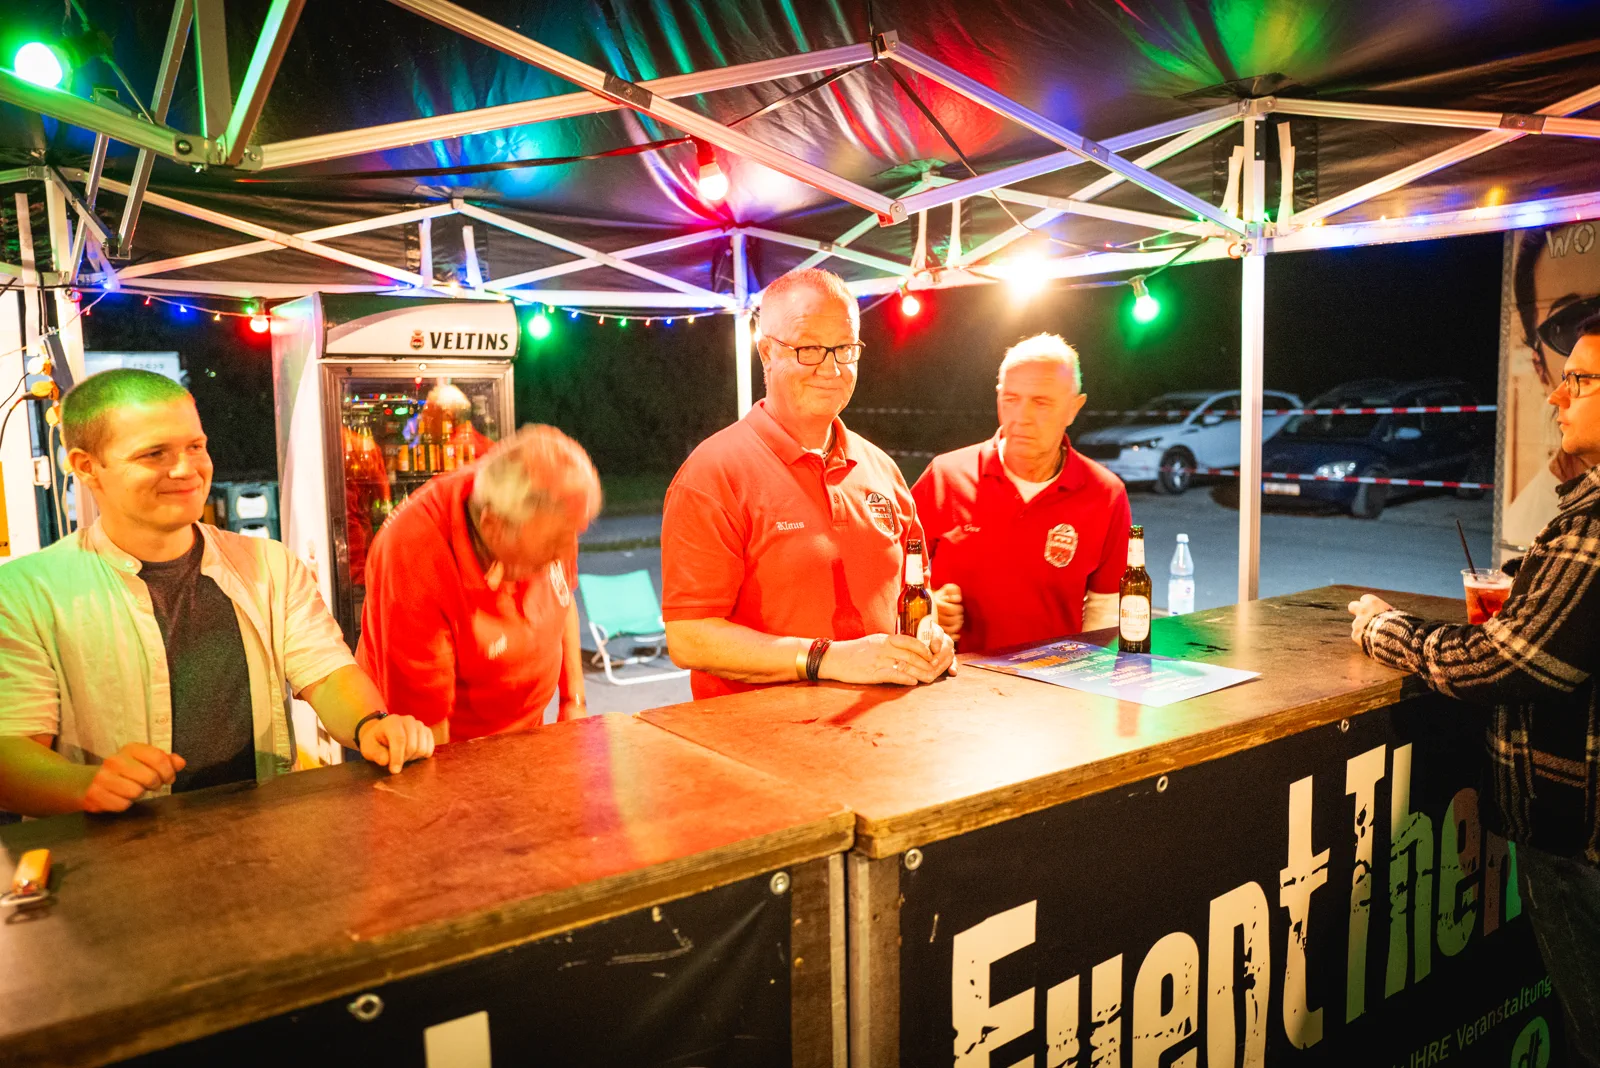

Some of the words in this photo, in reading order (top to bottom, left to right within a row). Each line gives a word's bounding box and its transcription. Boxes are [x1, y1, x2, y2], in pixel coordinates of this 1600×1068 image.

[1545, 223, 1596, 258] WO
[430, 331, 509, 350] VELTINS
[1410, 1033, 1452, 1068] IHRE
